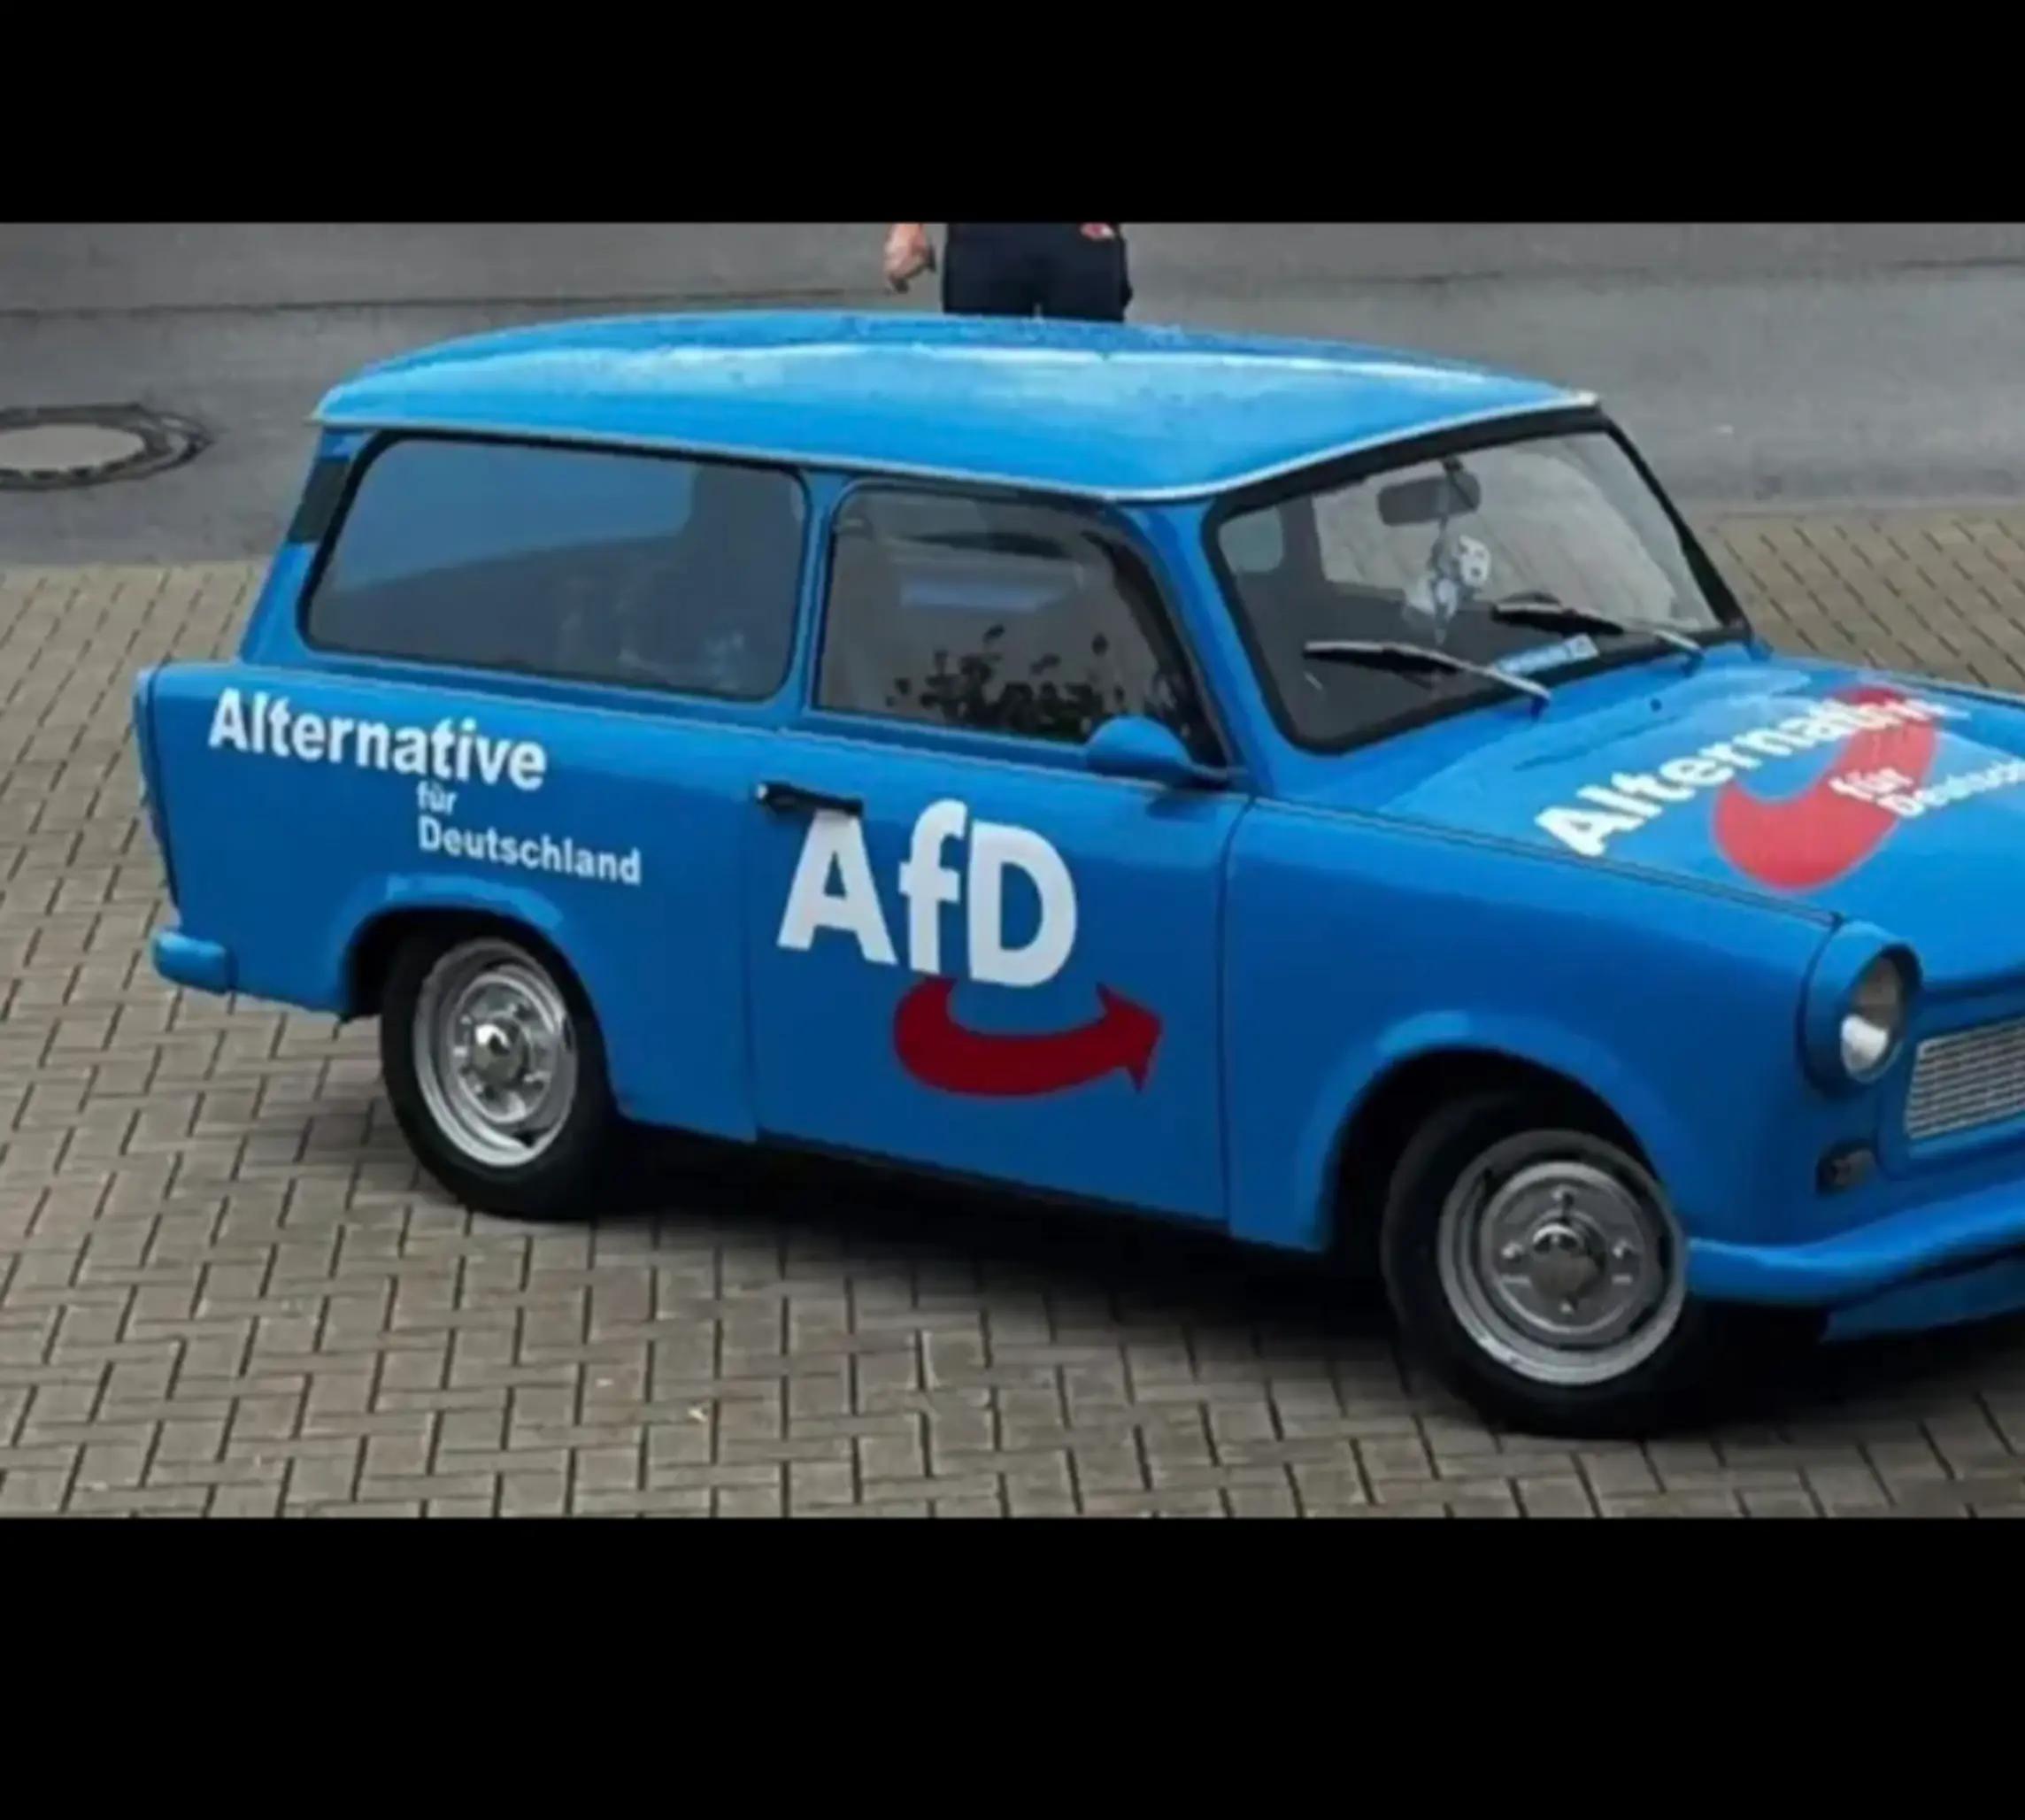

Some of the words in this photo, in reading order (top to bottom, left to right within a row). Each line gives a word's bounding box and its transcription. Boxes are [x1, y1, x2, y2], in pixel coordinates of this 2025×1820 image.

[209, 688, 547, 791] Alternative
[417, 781, 458, 816] für
[418, 814, 642, 885] Deutschland
[775, 798, 1078, 989] AfD
